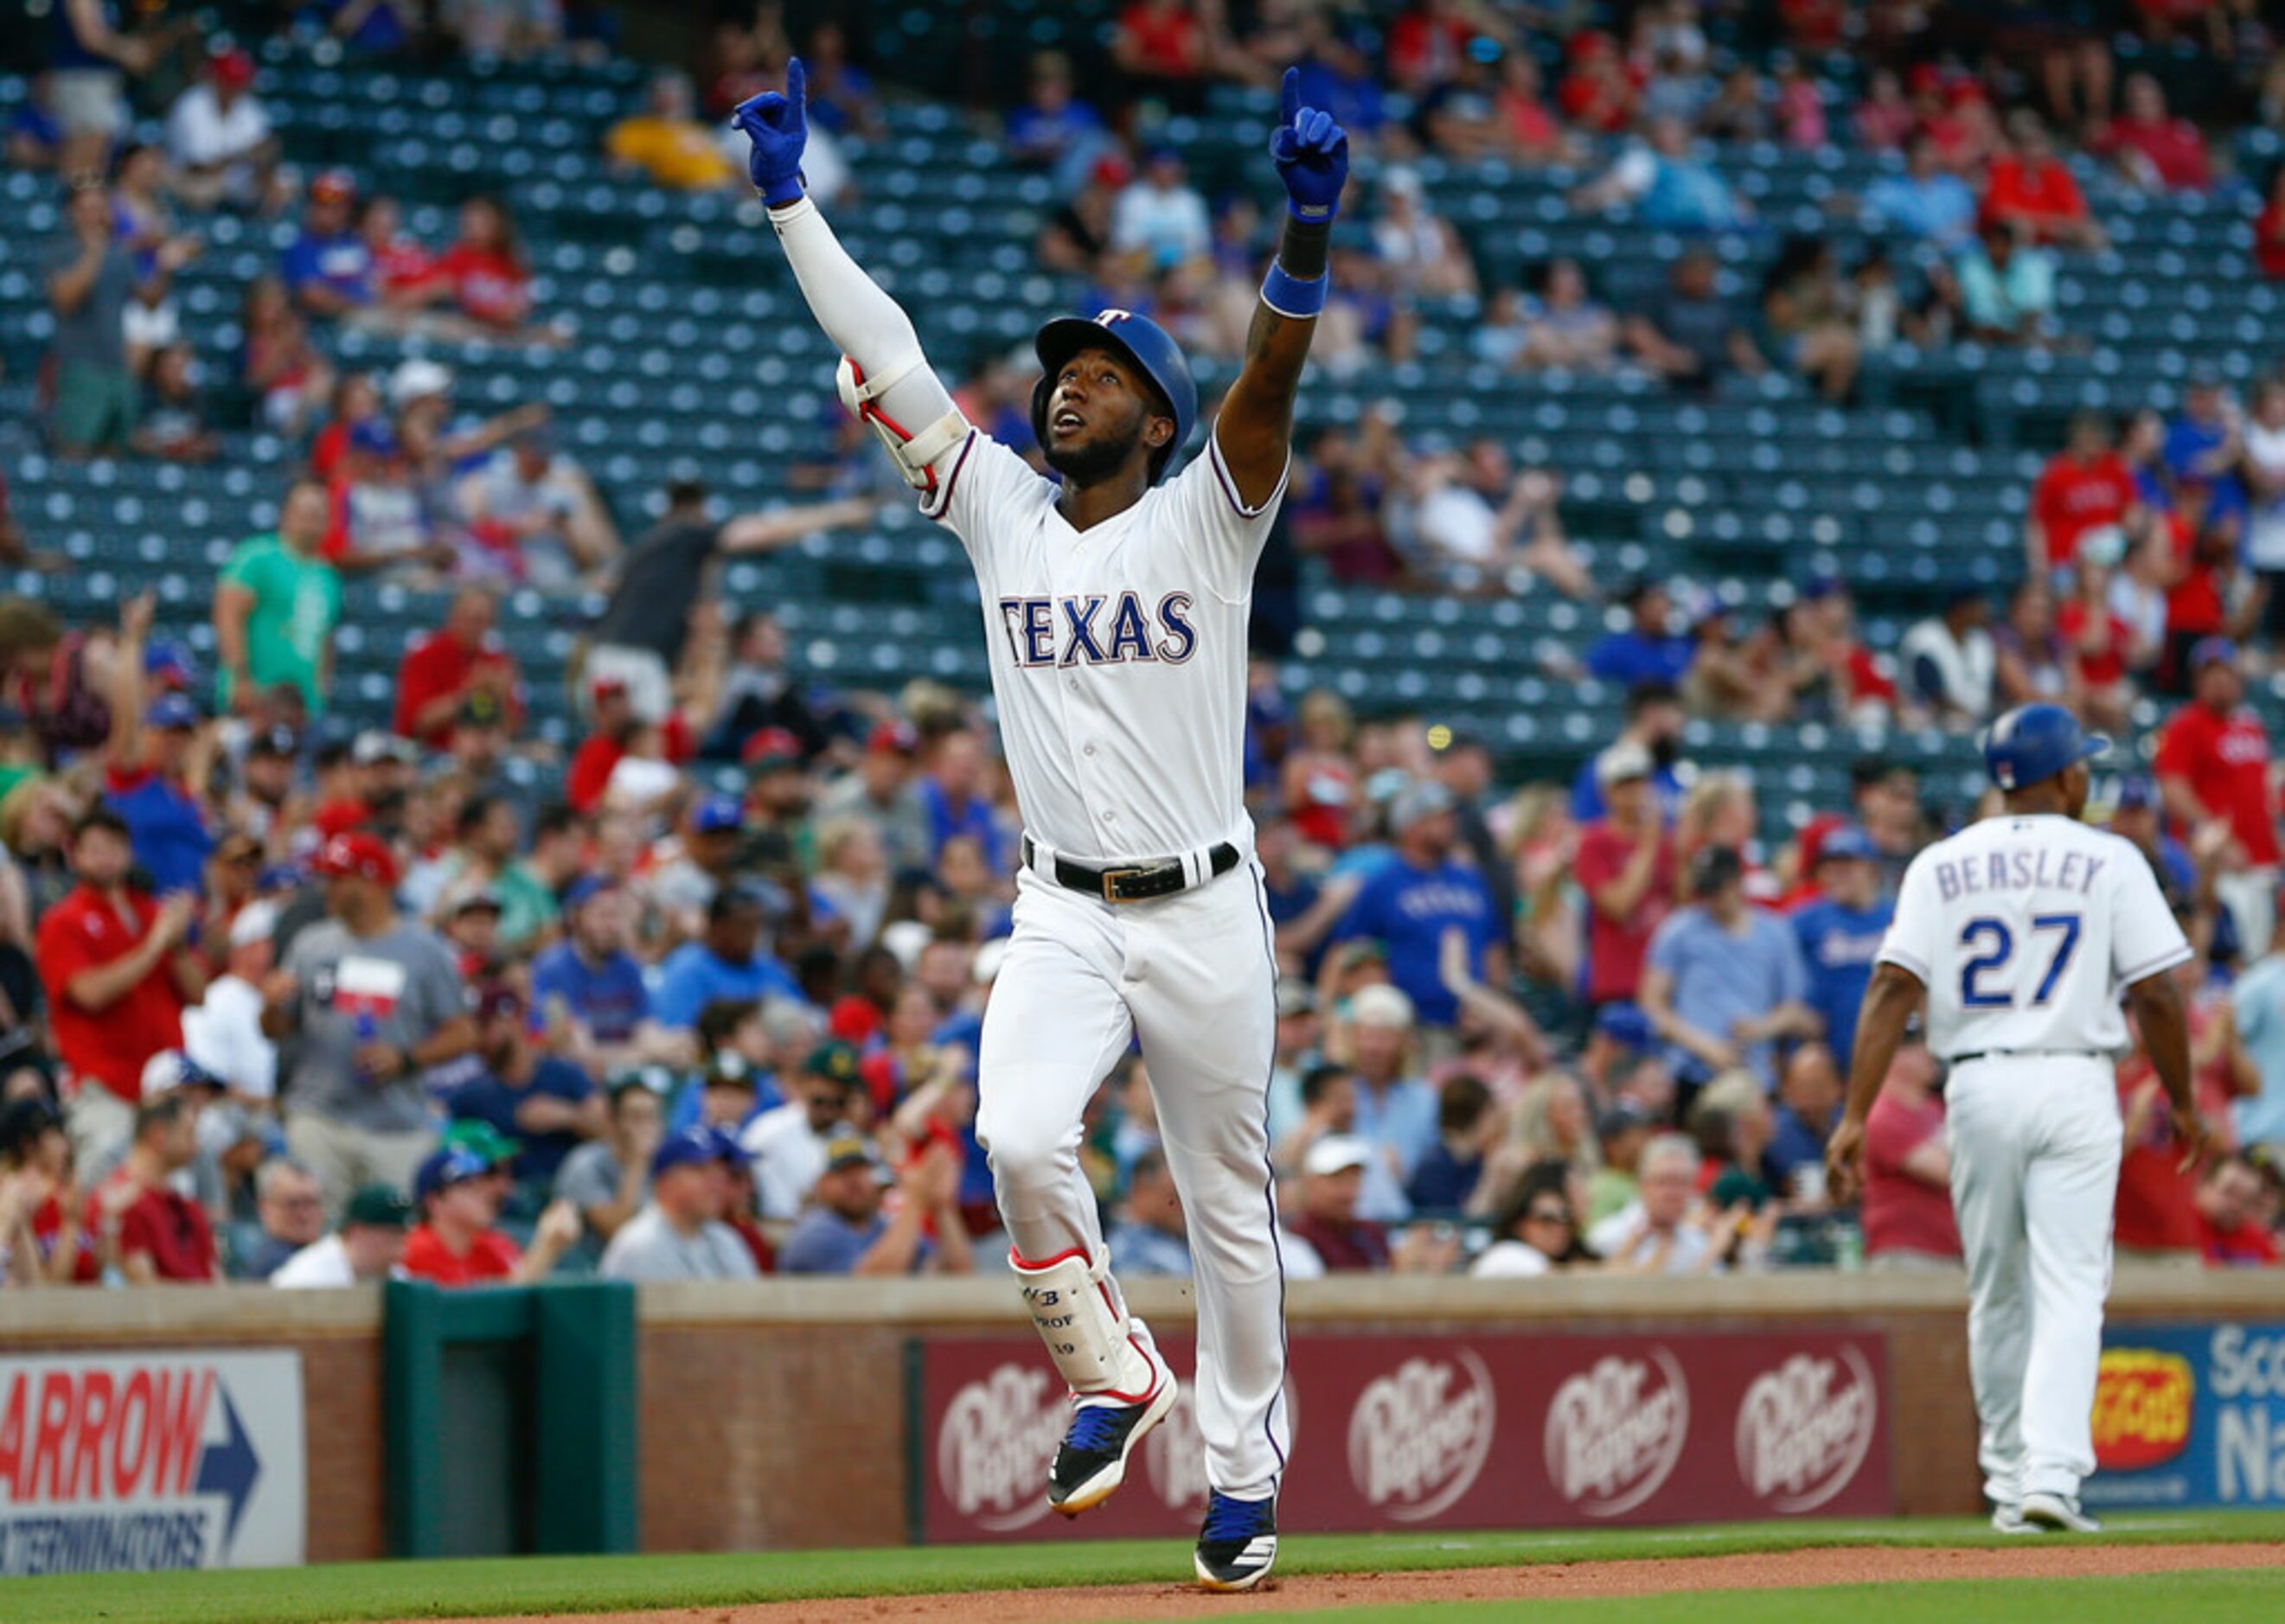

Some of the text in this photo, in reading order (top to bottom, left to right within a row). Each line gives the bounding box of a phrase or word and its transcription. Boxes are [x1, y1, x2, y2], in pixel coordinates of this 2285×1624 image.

[999, 591, 1199, 668] TEXAS
[1936, 847, 2105, 903] BEASLEY
[1960, 912, 2083, 1009] 27
[0, 1365, 218, 1503] ARROW
[1351, 1373, 1482, 1505] Pepper
[1546, 1371, 1676, 1500] Pepper
[1737, 1369, 1865, 1498] Pepper
